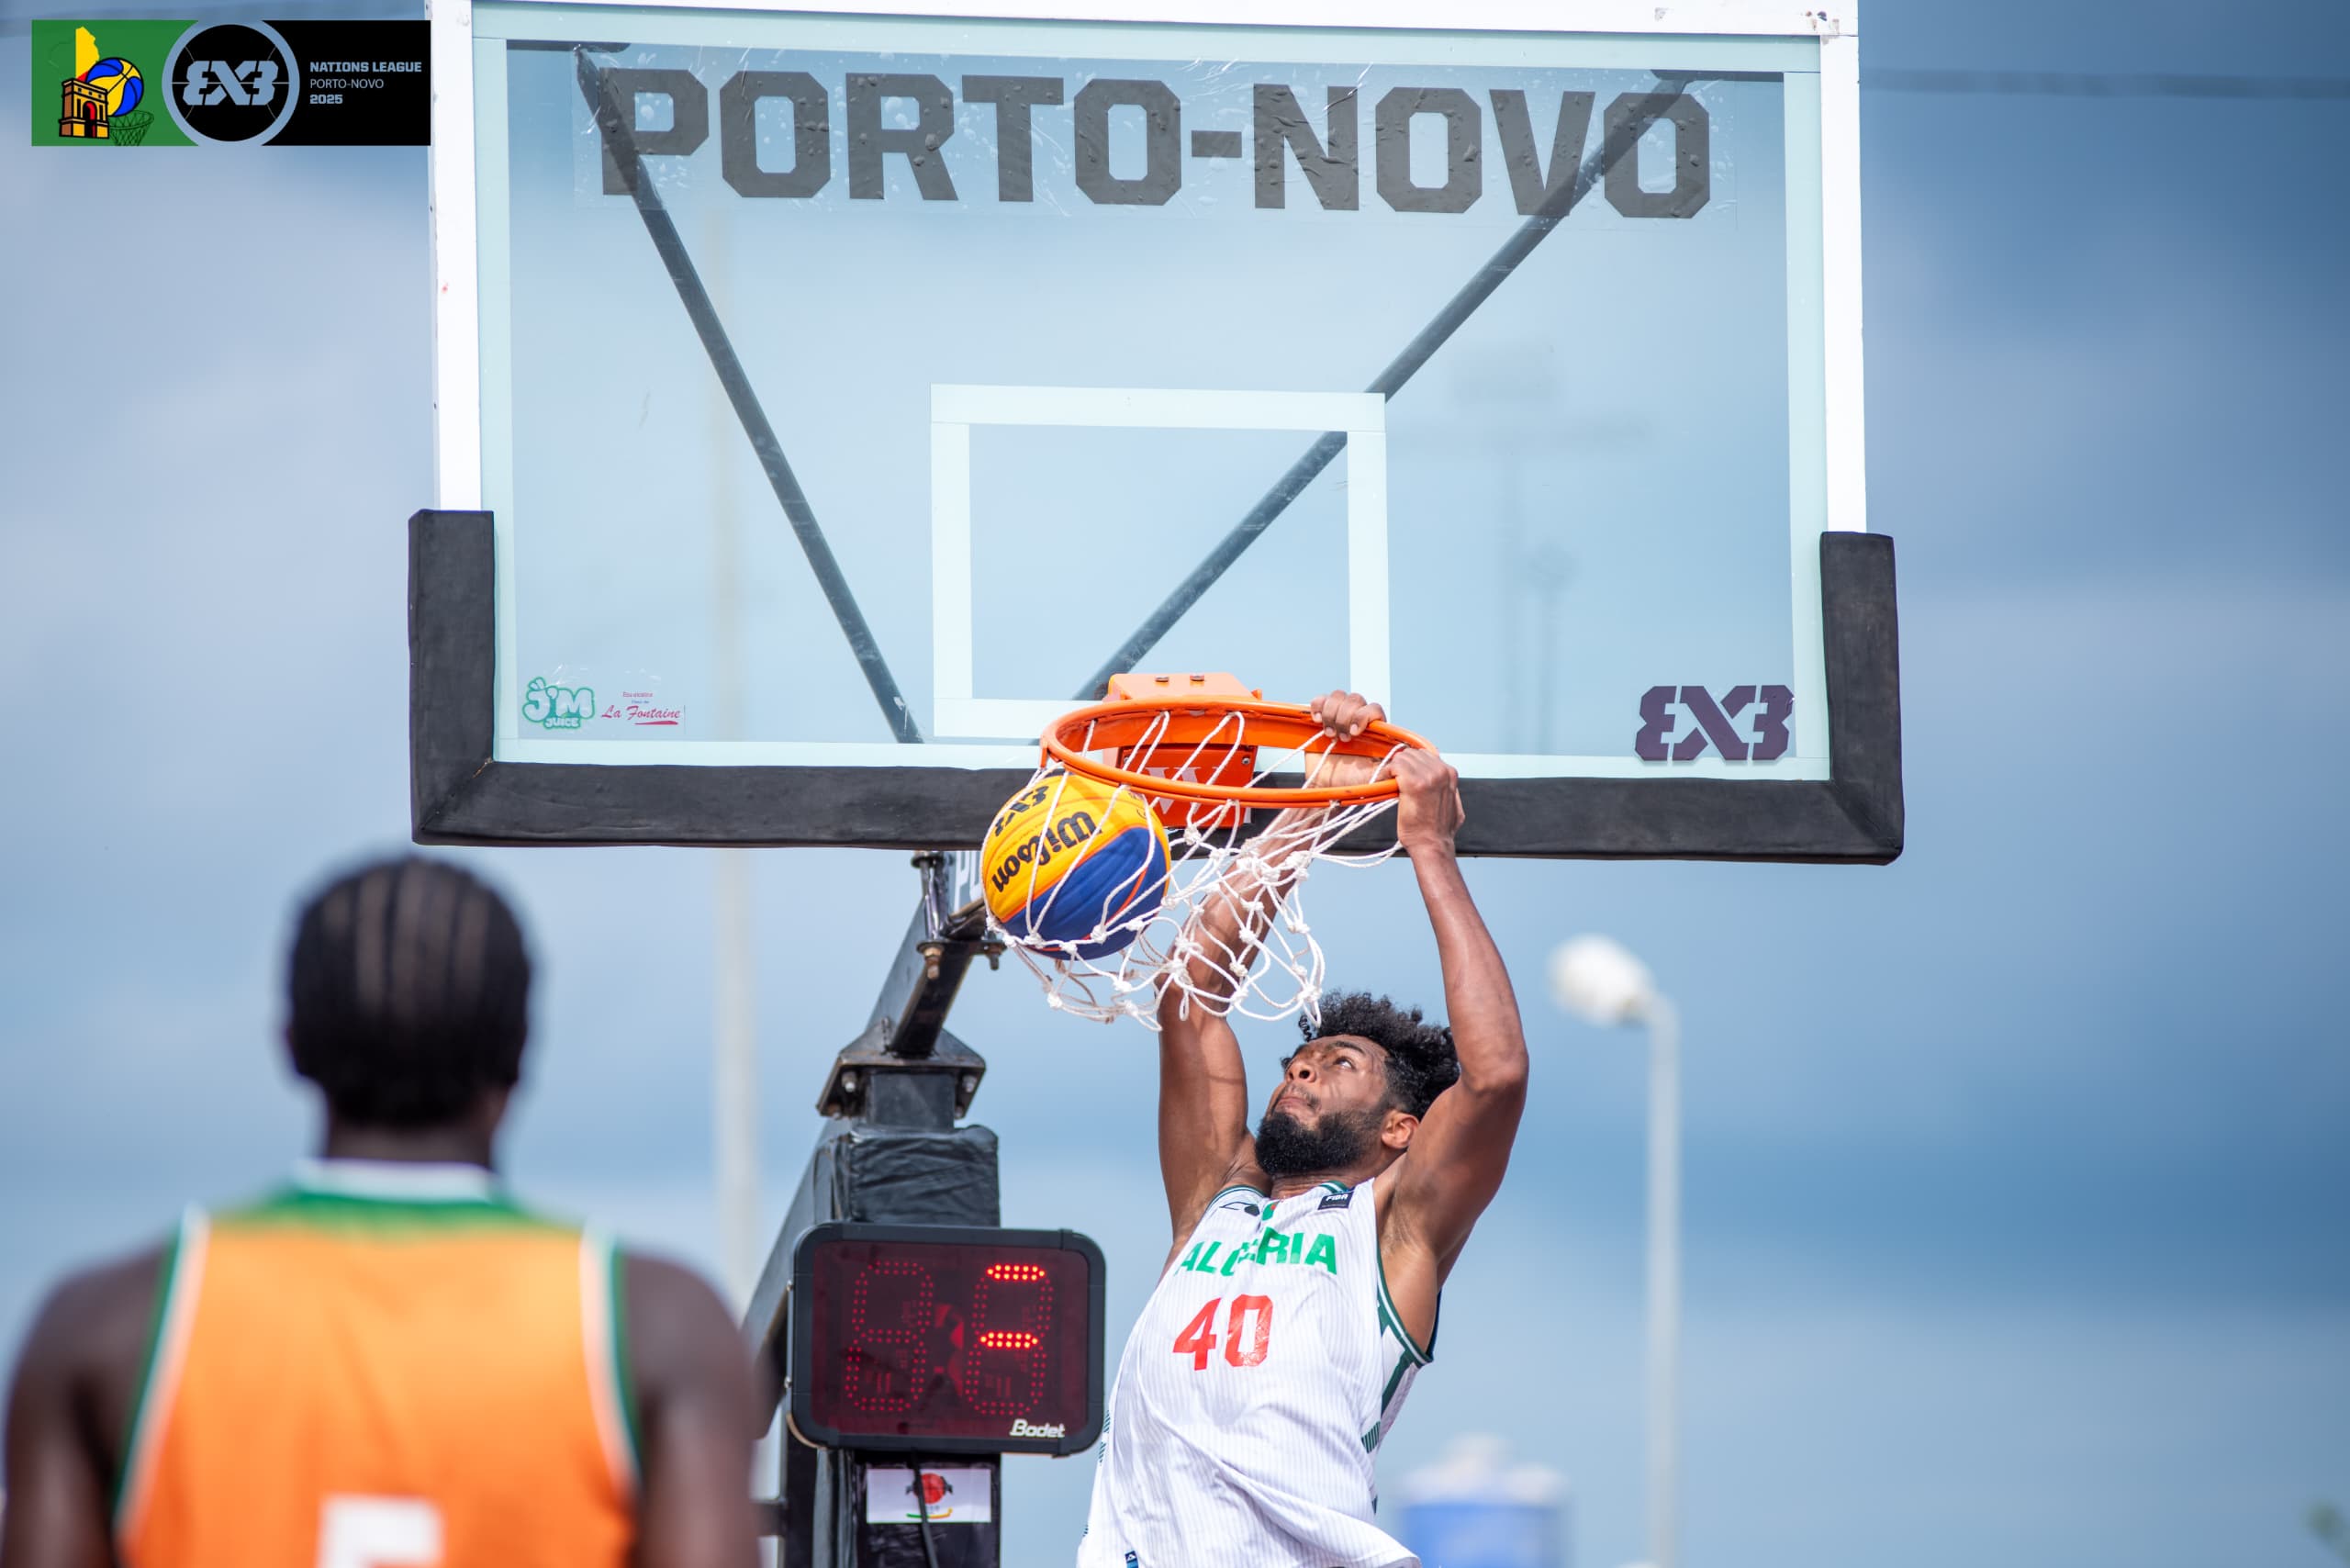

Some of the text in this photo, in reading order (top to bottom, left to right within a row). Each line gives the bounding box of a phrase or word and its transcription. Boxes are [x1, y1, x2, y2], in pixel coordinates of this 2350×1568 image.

[599, 67, 1710, 218] PORTO-NOVO
[544, 716, 580, 730] JUICE
[601, 704, 681, 721] La Fontaine
[990, 812, 1102, 892] Wilson
[1172, 1294, 1274, 1371] 40
[1009, 1417, 1066, 1439] Bodet
